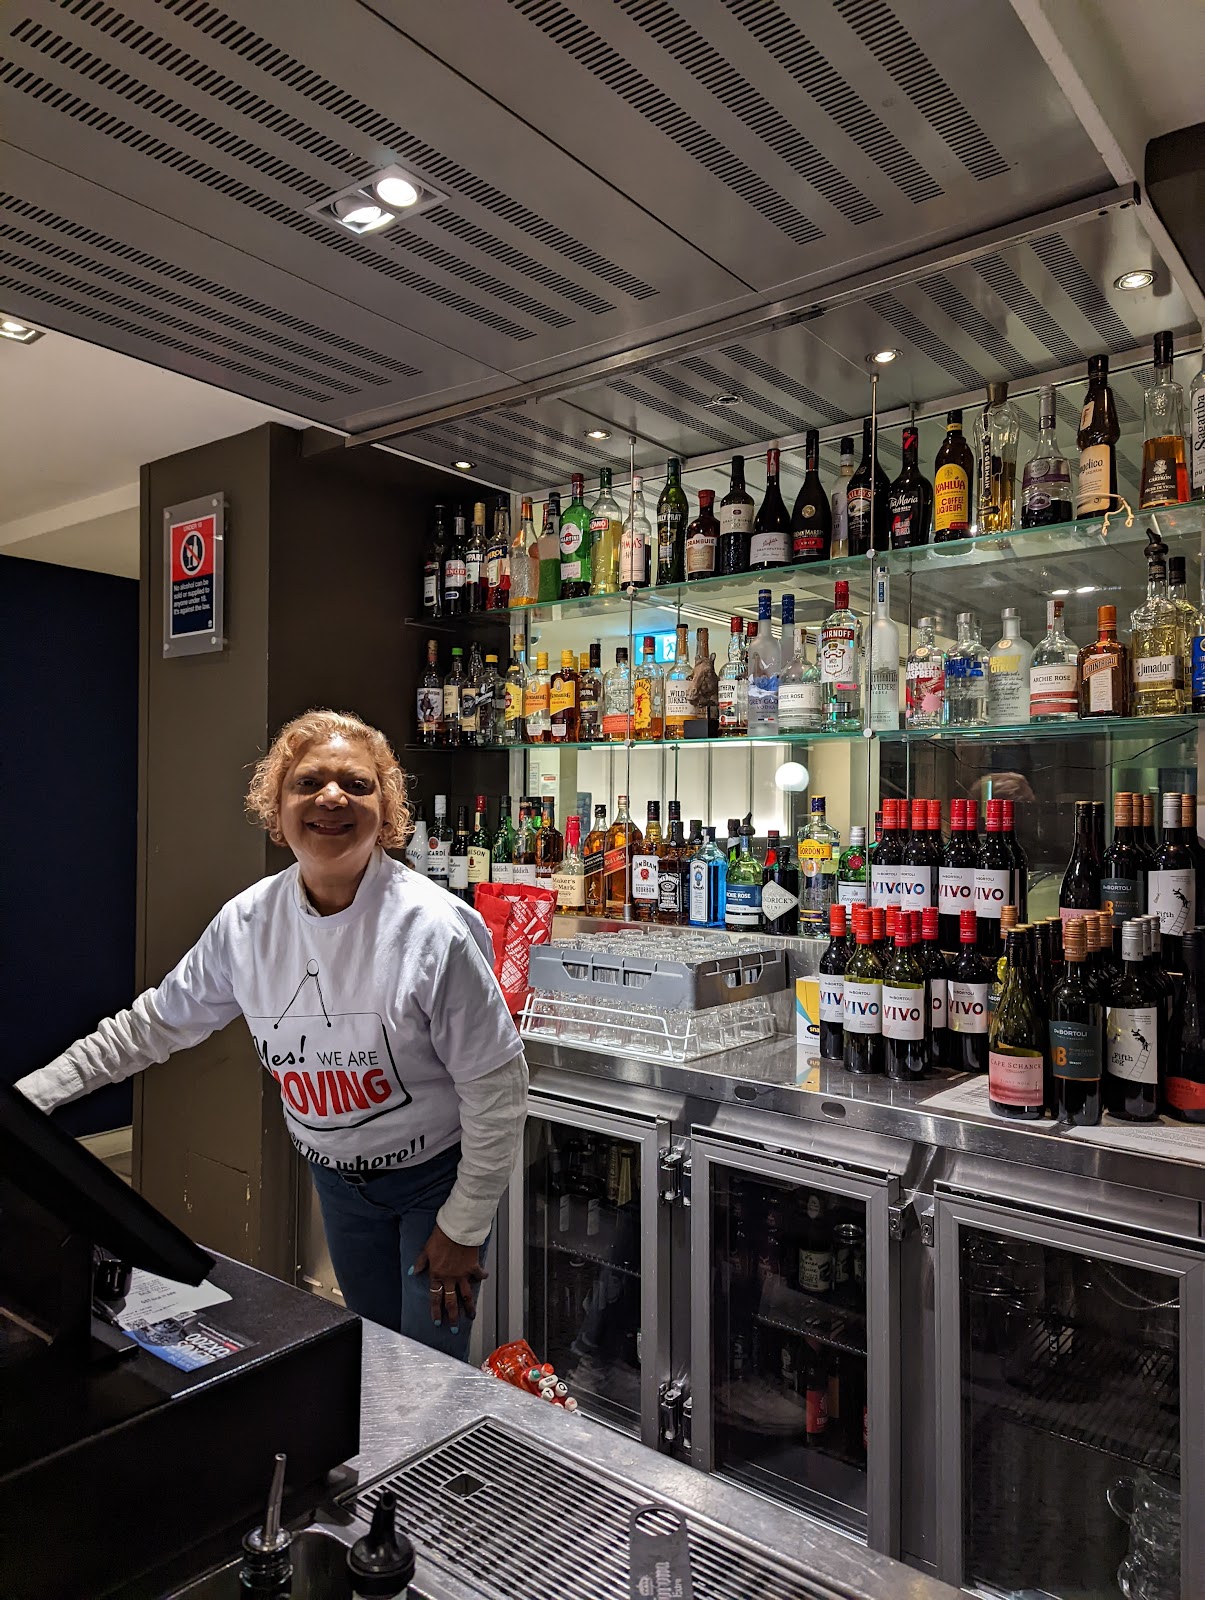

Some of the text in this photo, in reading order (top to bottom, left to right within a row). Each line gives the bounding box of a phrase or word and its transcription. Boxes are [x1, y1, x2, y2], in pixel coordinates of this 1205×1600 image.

[936, 476, 966, 494] KAHLÚA
[848, 488, 872, 501] AILEYS
[941, 496, 964, 506] COFFEE
[936, 503, 962, 515] LIQUEUR
[669, 513, 682, 521] PRAT
[183, 524, 196, 532] UNDER
[560, 534, 580, 544] MARTINI
[687, 537, 716, 547] DRAMBUIE
[180, 583, 195, 591] alcohol
[188, 588, 203, 598] supplied
[174, 600, 188, 608] anyone
[188, 598, 201, 606] under
[180, 606, 195, 615] against
[822, 629, 852, 639] MIRNOFF
[1085, 656, 1118, 676] COINTREAU
[1138, 659, 1171, 677] Jimador
[670, 690, 686, 698] WILD
[749, 697, 779, 706] GREY GOO
[428, 849, 447, 857] CARDÍ
[799, 846, 826, 856] GORDON'S
[634, 860, 657, 871] JIM BEAM
[764, 896, 794, 904] DRICK'S
[840, 895, 867, 904] Tanquer
[1155, 911, 1174, 919] Fifth
[515, 954, 528, 967] And
[820, 990, 844, 1005] VIV
[844, 999, 879, 1016] VIVO
[948, 999, 984, 1015] VIVO
[883, 1004, 920, 1021] VIVO
[809, 1025, 820, 1033] sna
[253, 1035, 380, 1073] Yes! WE ARE
[1113, 1051, 1134, 1063] Fifth
[990, 1059, 1042, 1071] CAPE SCHANCK
[1111, 1058, 1125, 1067] Leg
[305, 1135, 425, 1172] me where!!
[655, 1561, 671, 1600] orona
[671, 1577, 683, 1598] Extra
